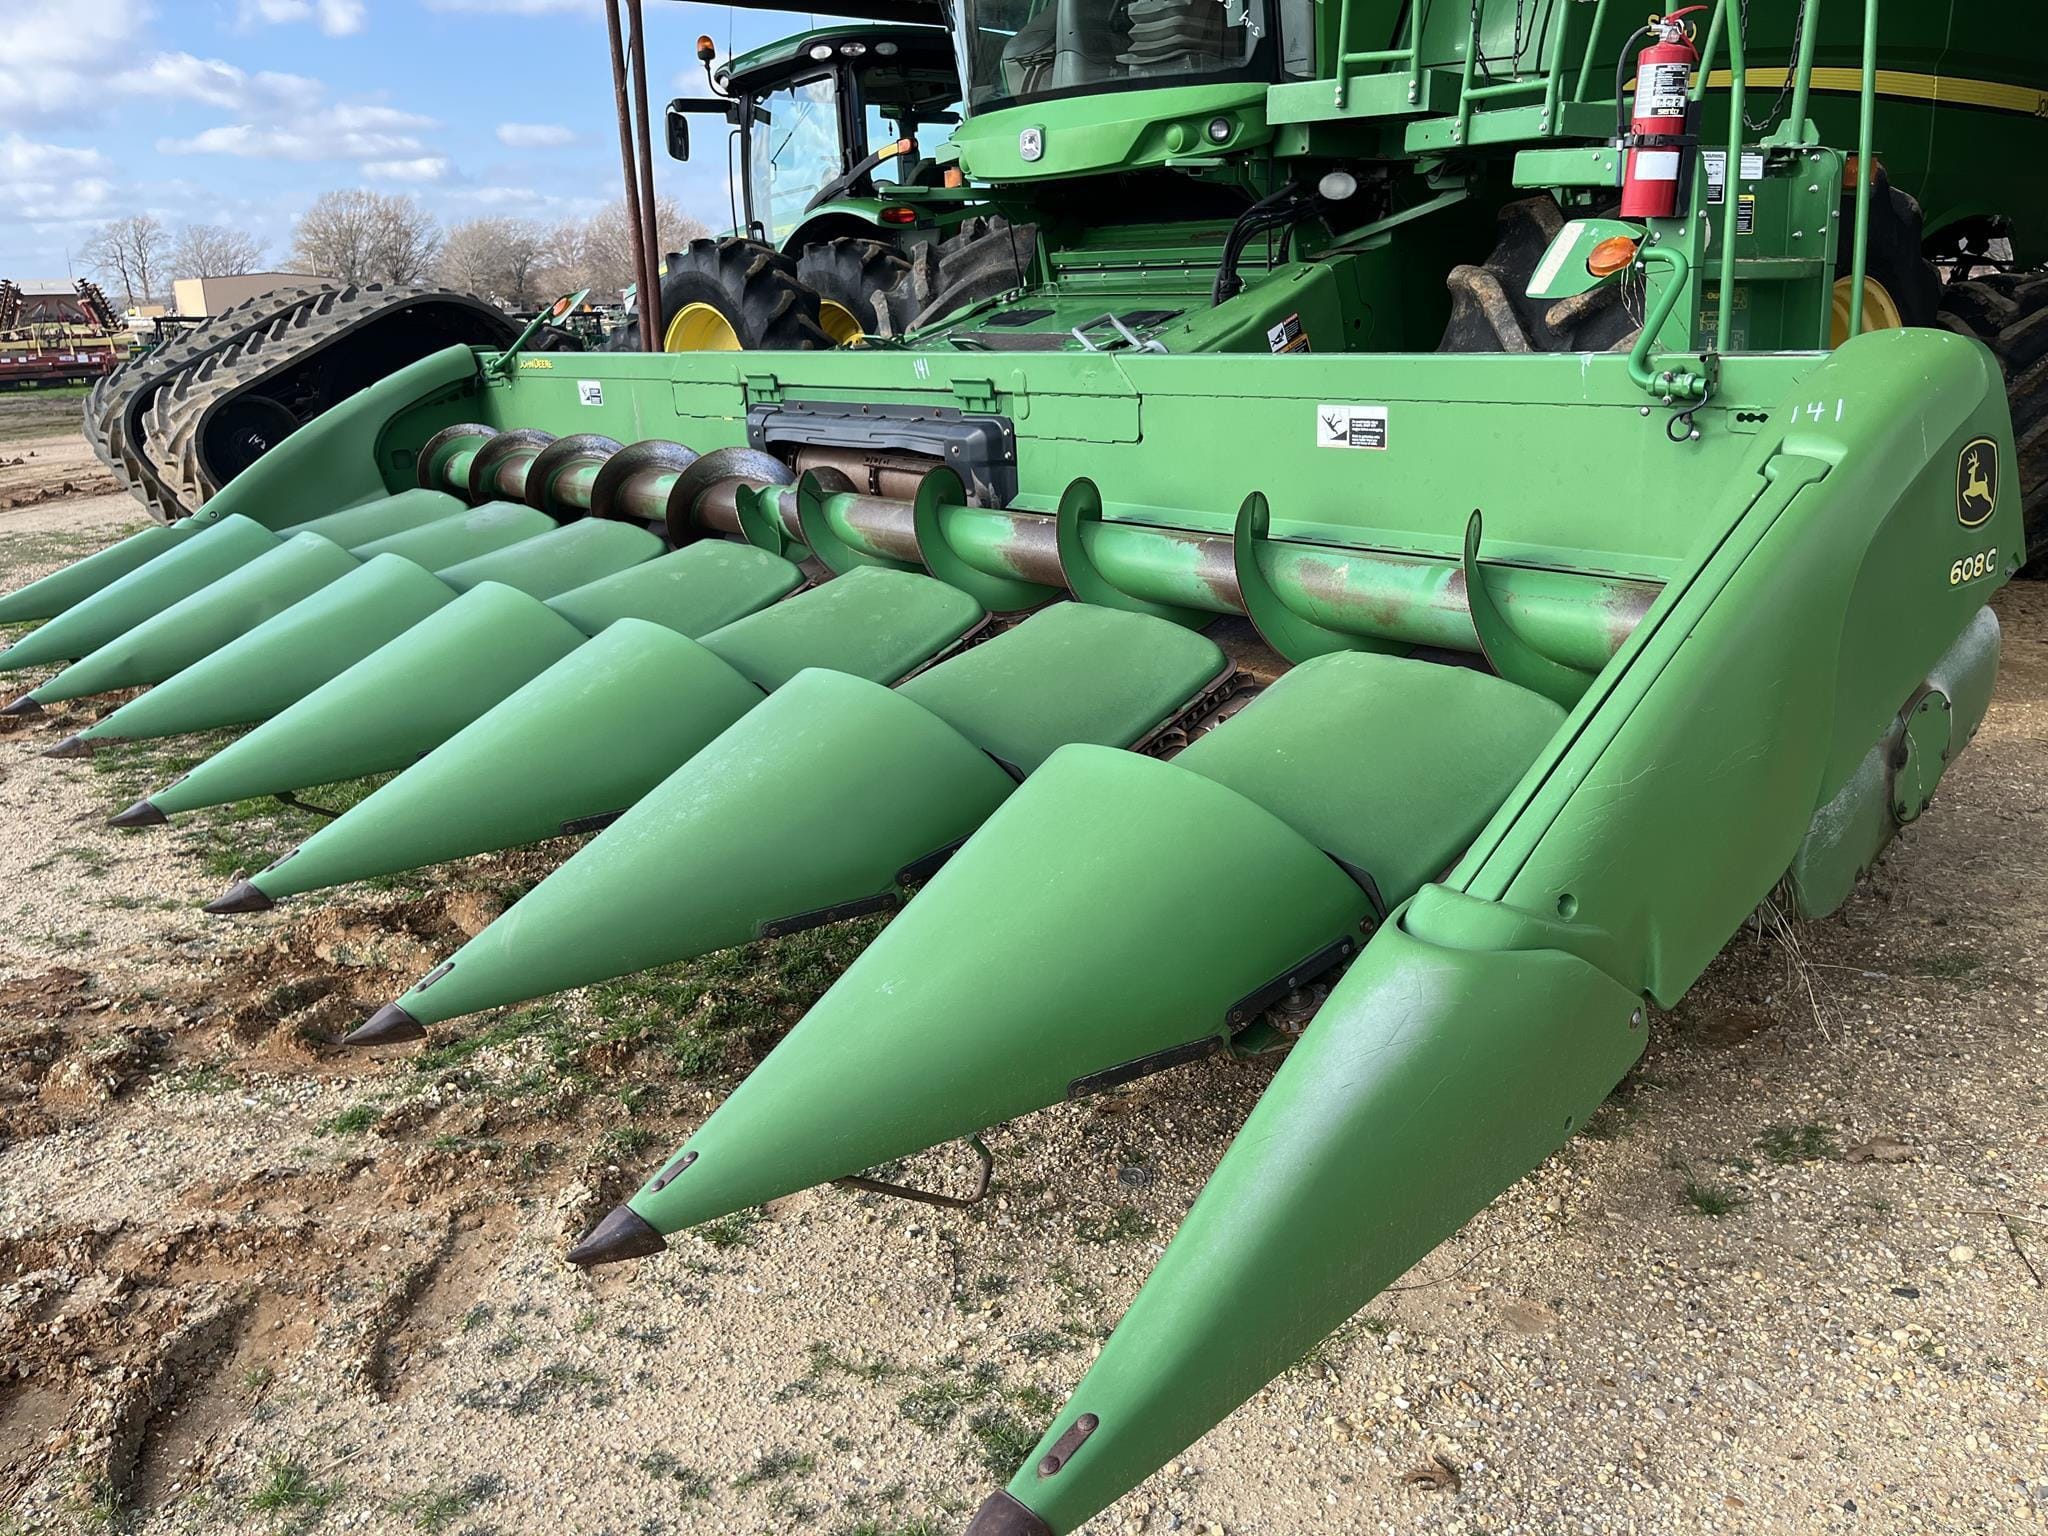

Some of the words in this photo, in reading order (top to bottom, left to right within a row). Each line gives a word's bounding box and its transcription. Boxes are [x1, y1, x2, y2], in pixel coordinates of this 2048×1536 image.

[1238, 9, 1261, 37] hrs
[1790, 398, 1843, 424] 141
[1950, 547, 1997, 585] 608C
